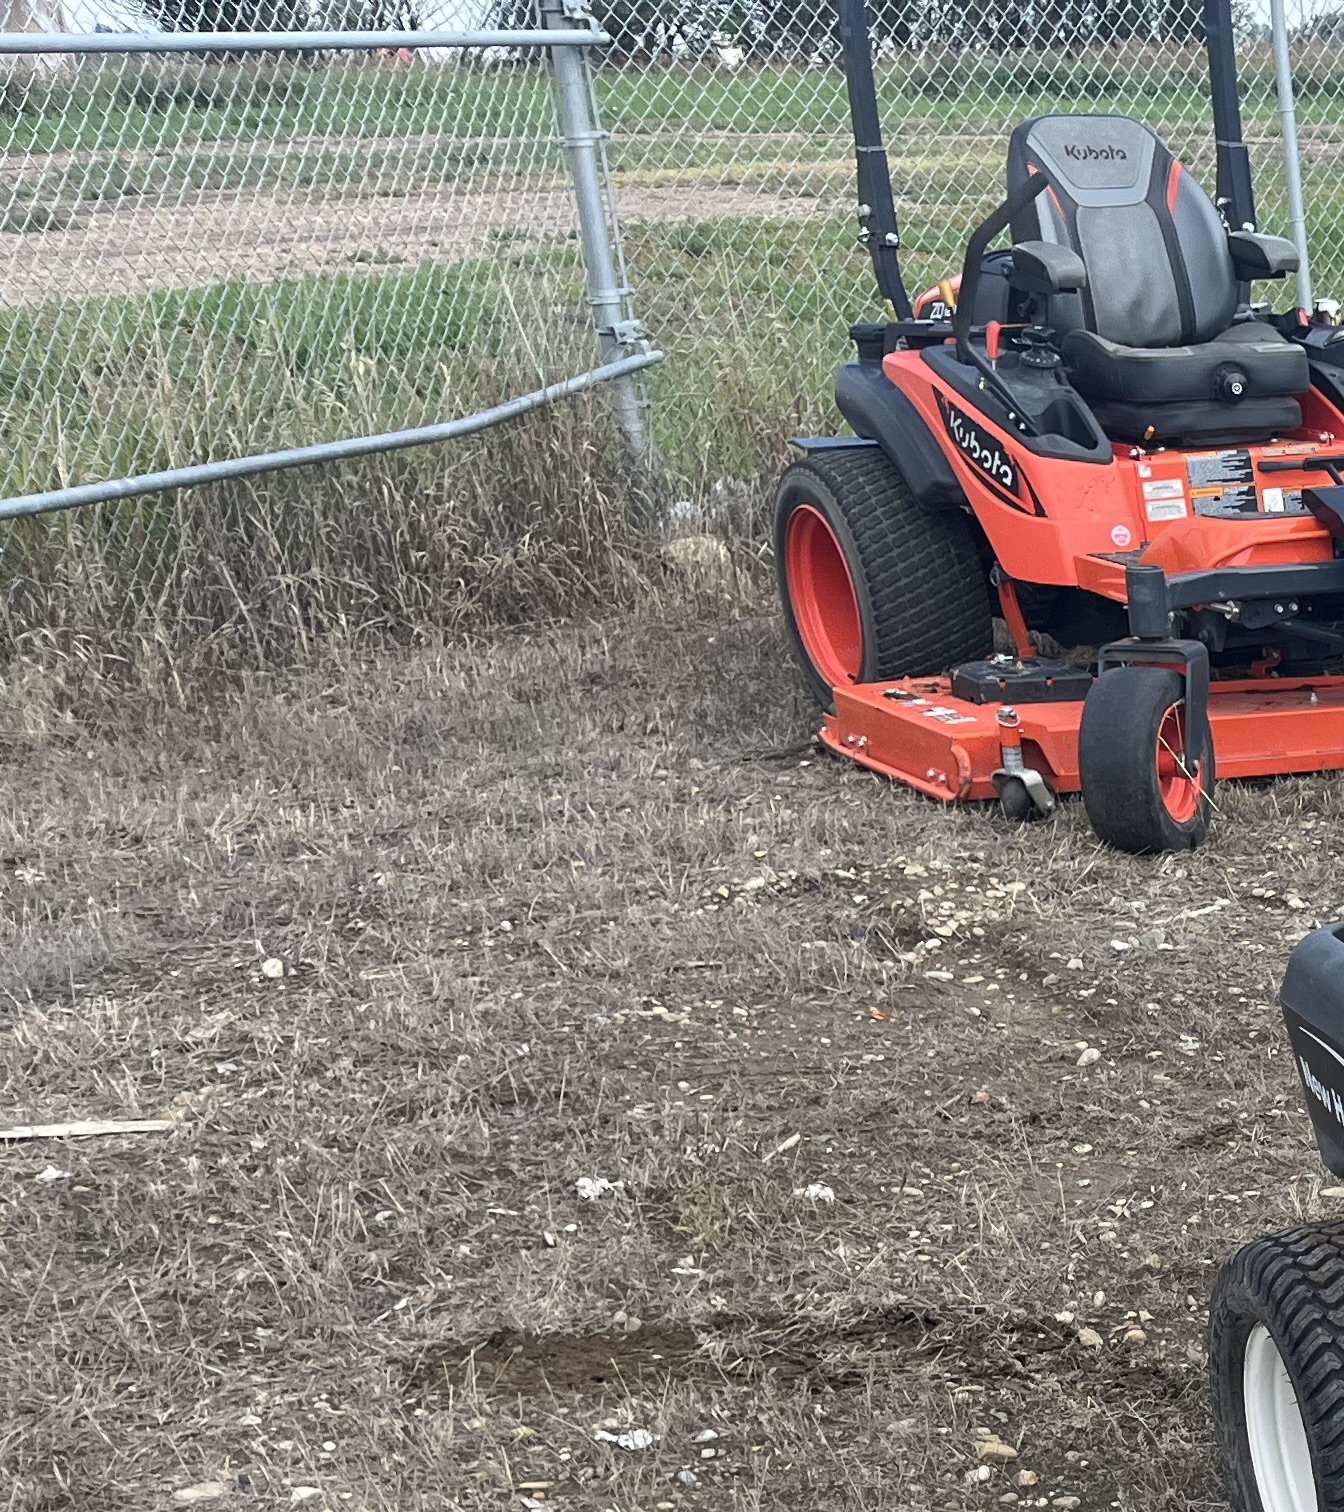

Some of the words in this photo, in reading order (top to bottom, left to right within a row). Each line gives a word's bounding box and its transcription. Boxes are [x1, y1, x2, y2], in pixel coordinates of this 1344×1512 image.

[1064, 144, 1127, 160] Kubota
[950, 410, 1013, 486] Kubota
[1299, 1055, 1332, 1113] New
